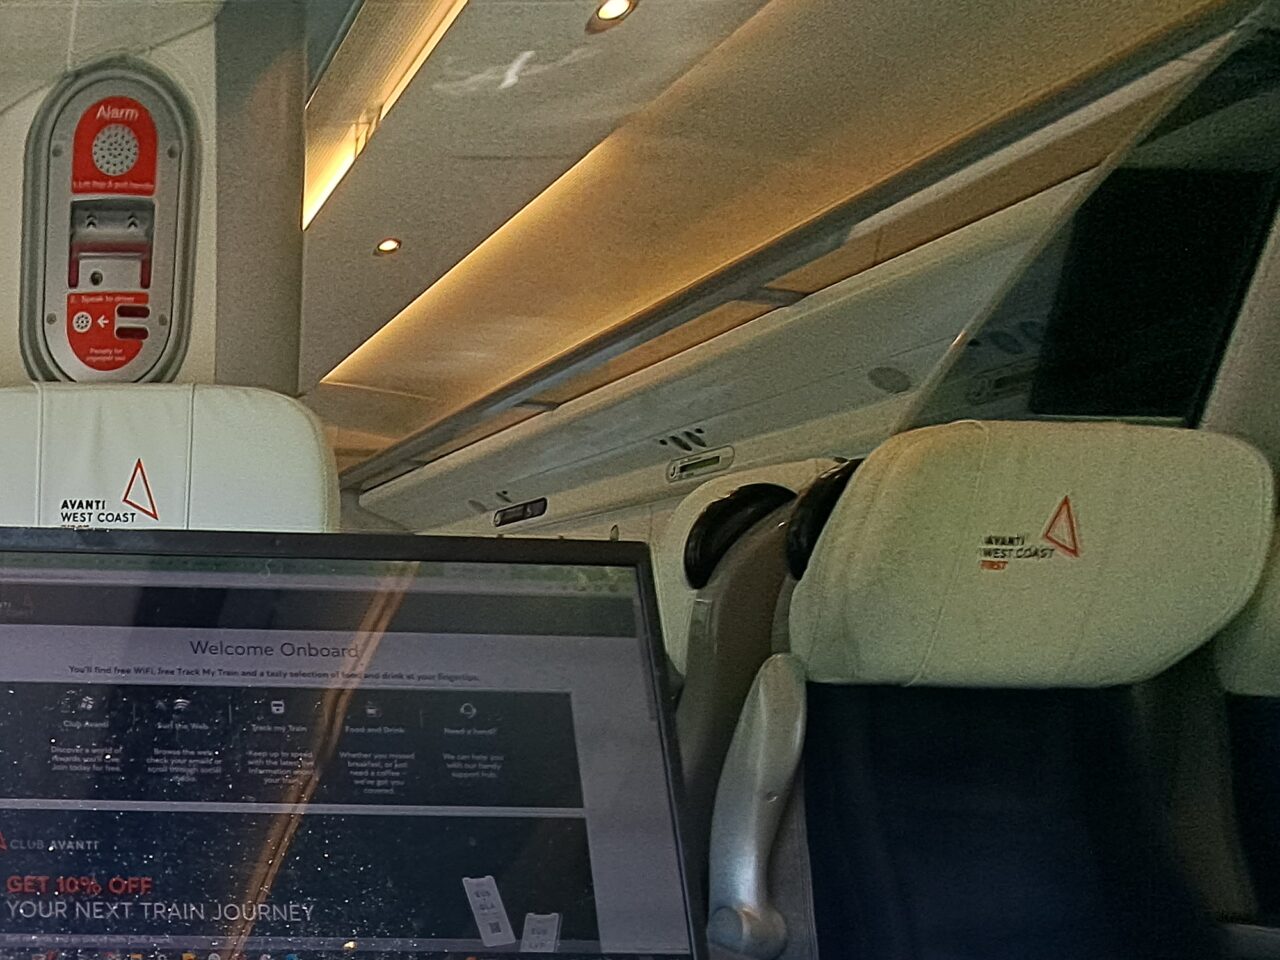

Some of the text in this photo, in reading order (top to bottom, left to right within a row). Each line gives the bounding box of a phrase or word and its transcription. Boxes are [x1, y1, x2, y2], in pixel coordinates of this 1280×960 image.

[96, 105, 139, 120] Alarm
[61, 500, 106, 510] AVANTI
[61, 513, 136, 523] WEST COAST
[983, 534, 1025, 546] AVANTI
[982, 547, 1055, 558] WEST COAST
[190, 640, 359, 657] Welcome Onboard
[69, 666, 92, 674] You'll
[94, 666, 111, 674] find
[114, 667, 131, 675] free
[157, 667, 175, 675] free
[177, 668, 199, 676] Track
[202, 668, 215, 677] My
[218, 669, 239, 677] Train
[266, 670, 288, 679] tasty
[289, 671, 329, 679] selection
[330, 671, 339, 679] of
[382, 672, 404, 680] drink
[417, 674, 435, 682] your
[288, 724, 307, 732] Train
[367, 726, 382, 734] and
[383, 726, 405, 734] Drink
[10, 839, 100, 850] CLUB AVANTI
[7, 876, 153, 895] GET 10% OFF
[7, 901, 315, 921] YOUR NEXT TRAIN JOURNEY
